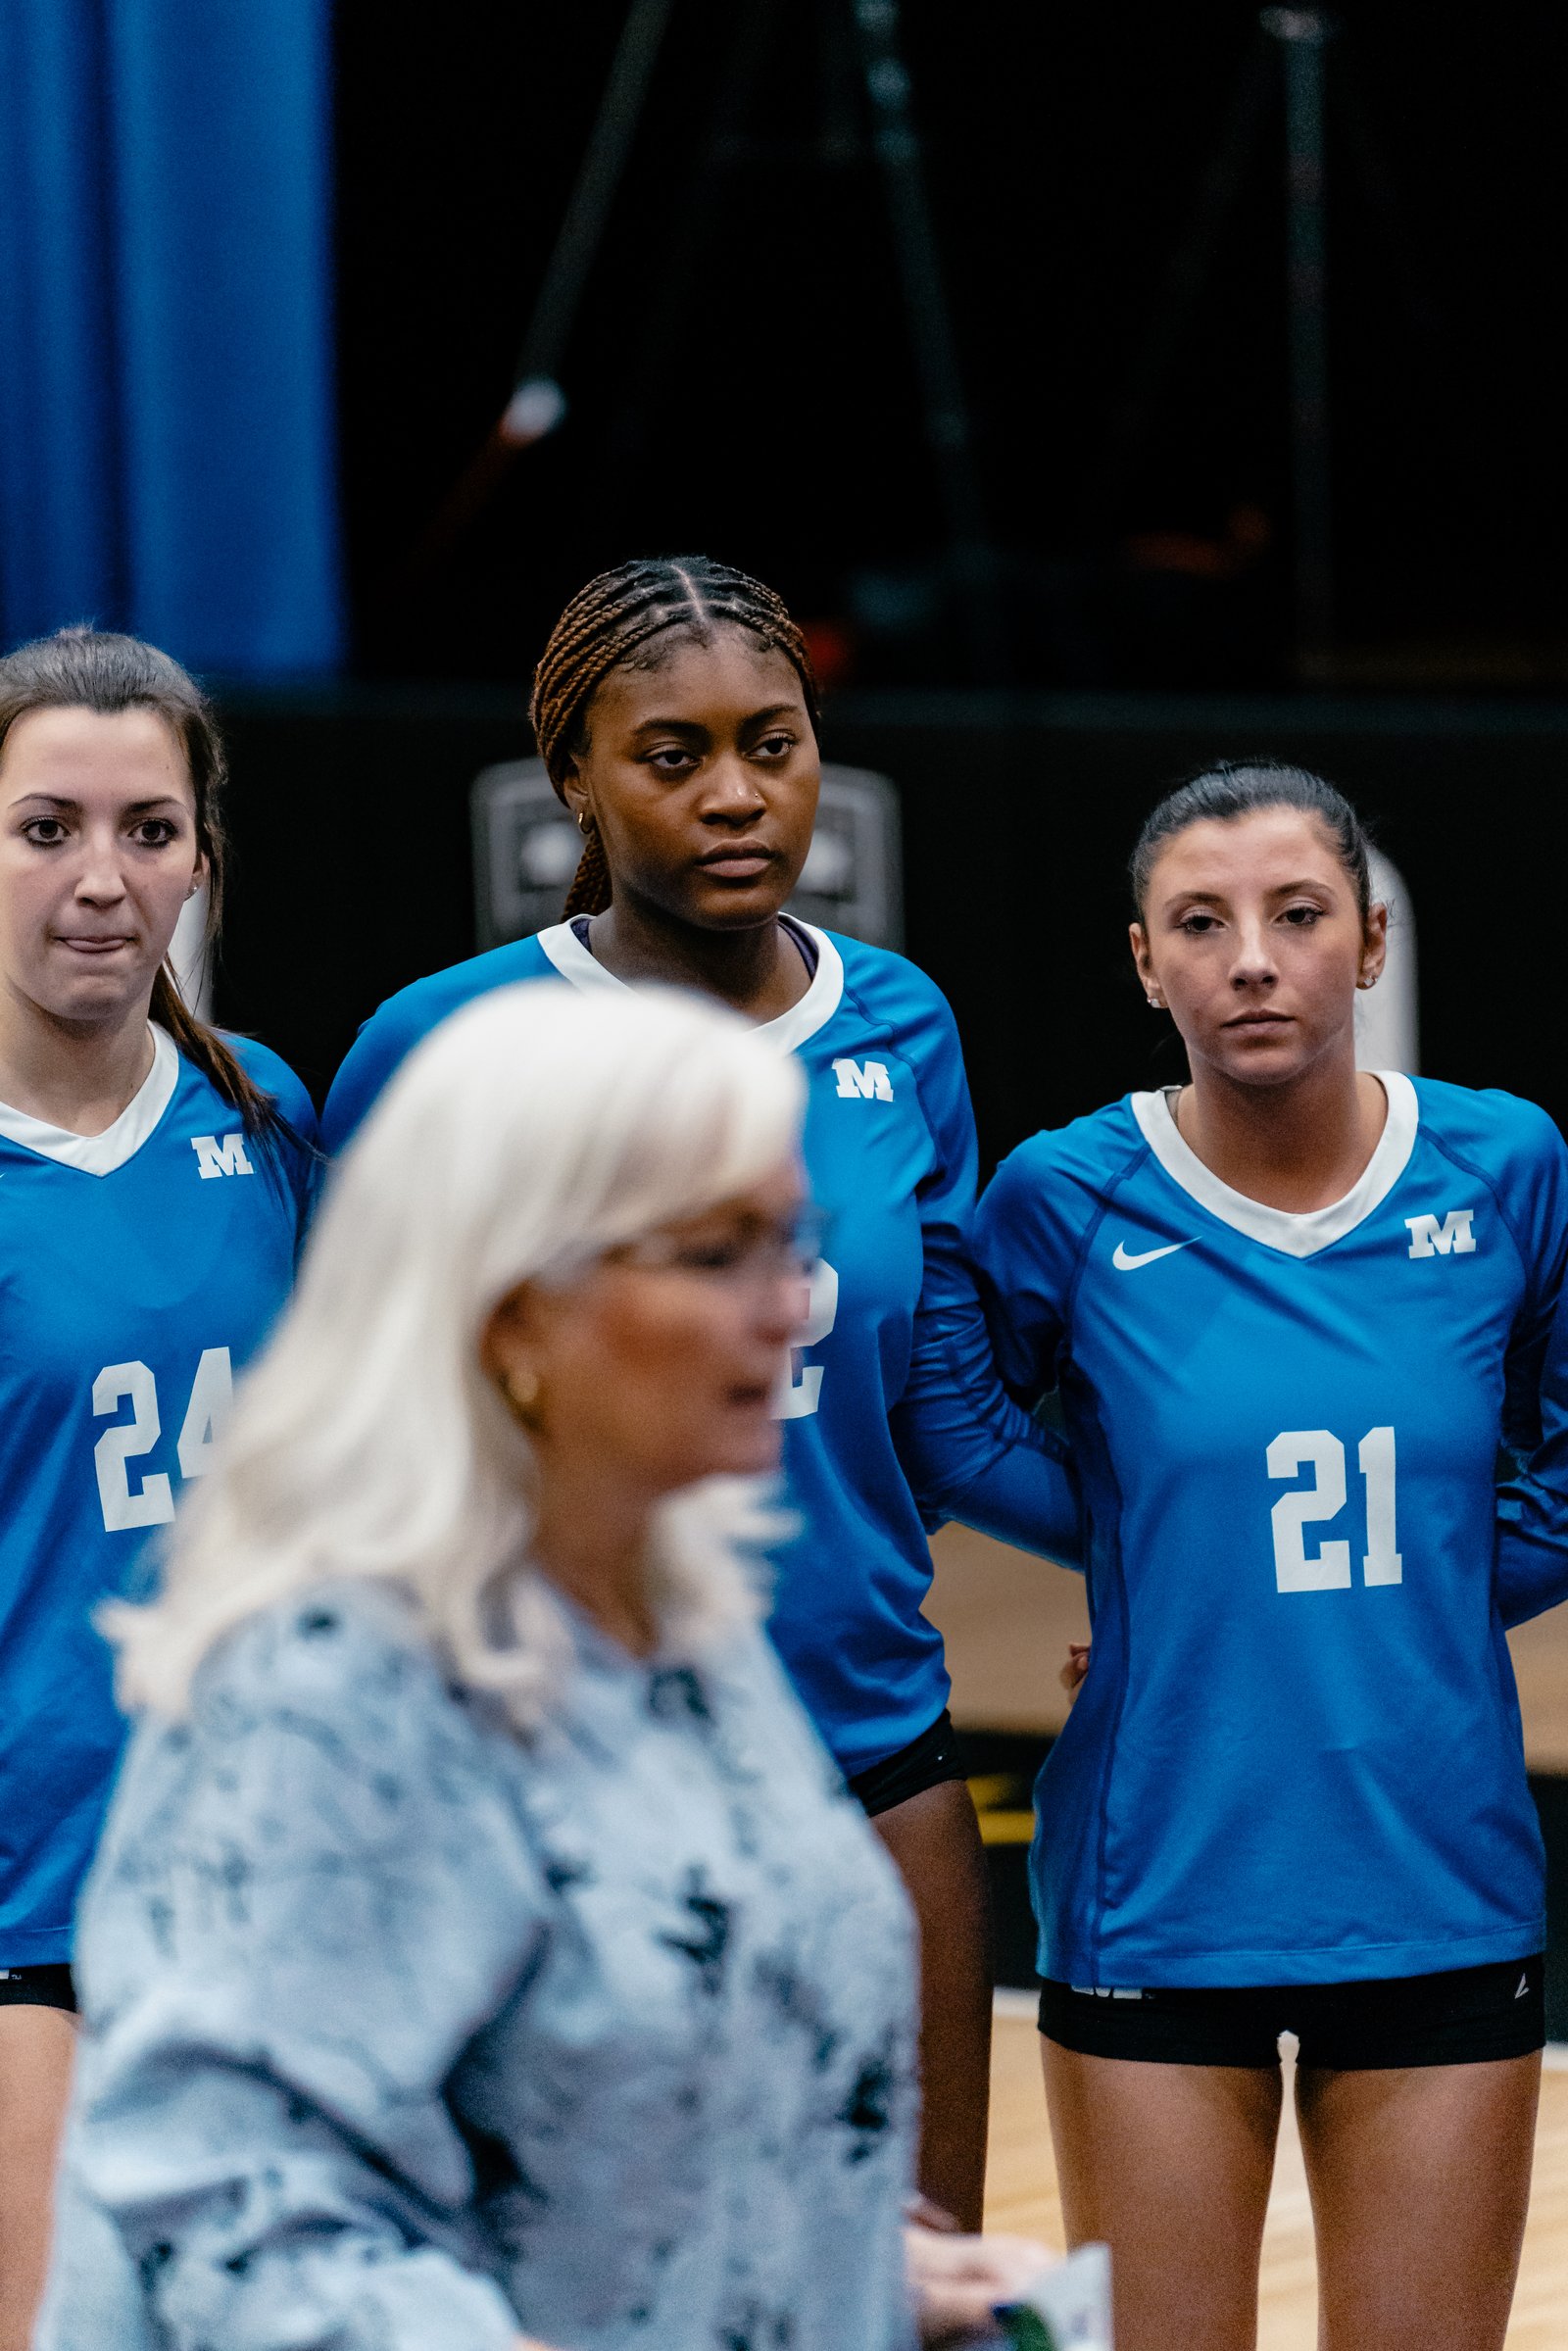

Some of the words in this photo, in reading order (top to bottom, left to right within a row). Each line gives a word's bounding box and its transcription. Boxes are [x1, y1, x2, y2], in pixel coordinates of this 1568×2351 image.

[832, 1057, 894, 1102] M
[191, 1133, 254, 1179] M
[1404, 1209, 1477, 1259] M
[1265, 1426, 1402, 1593] 21
